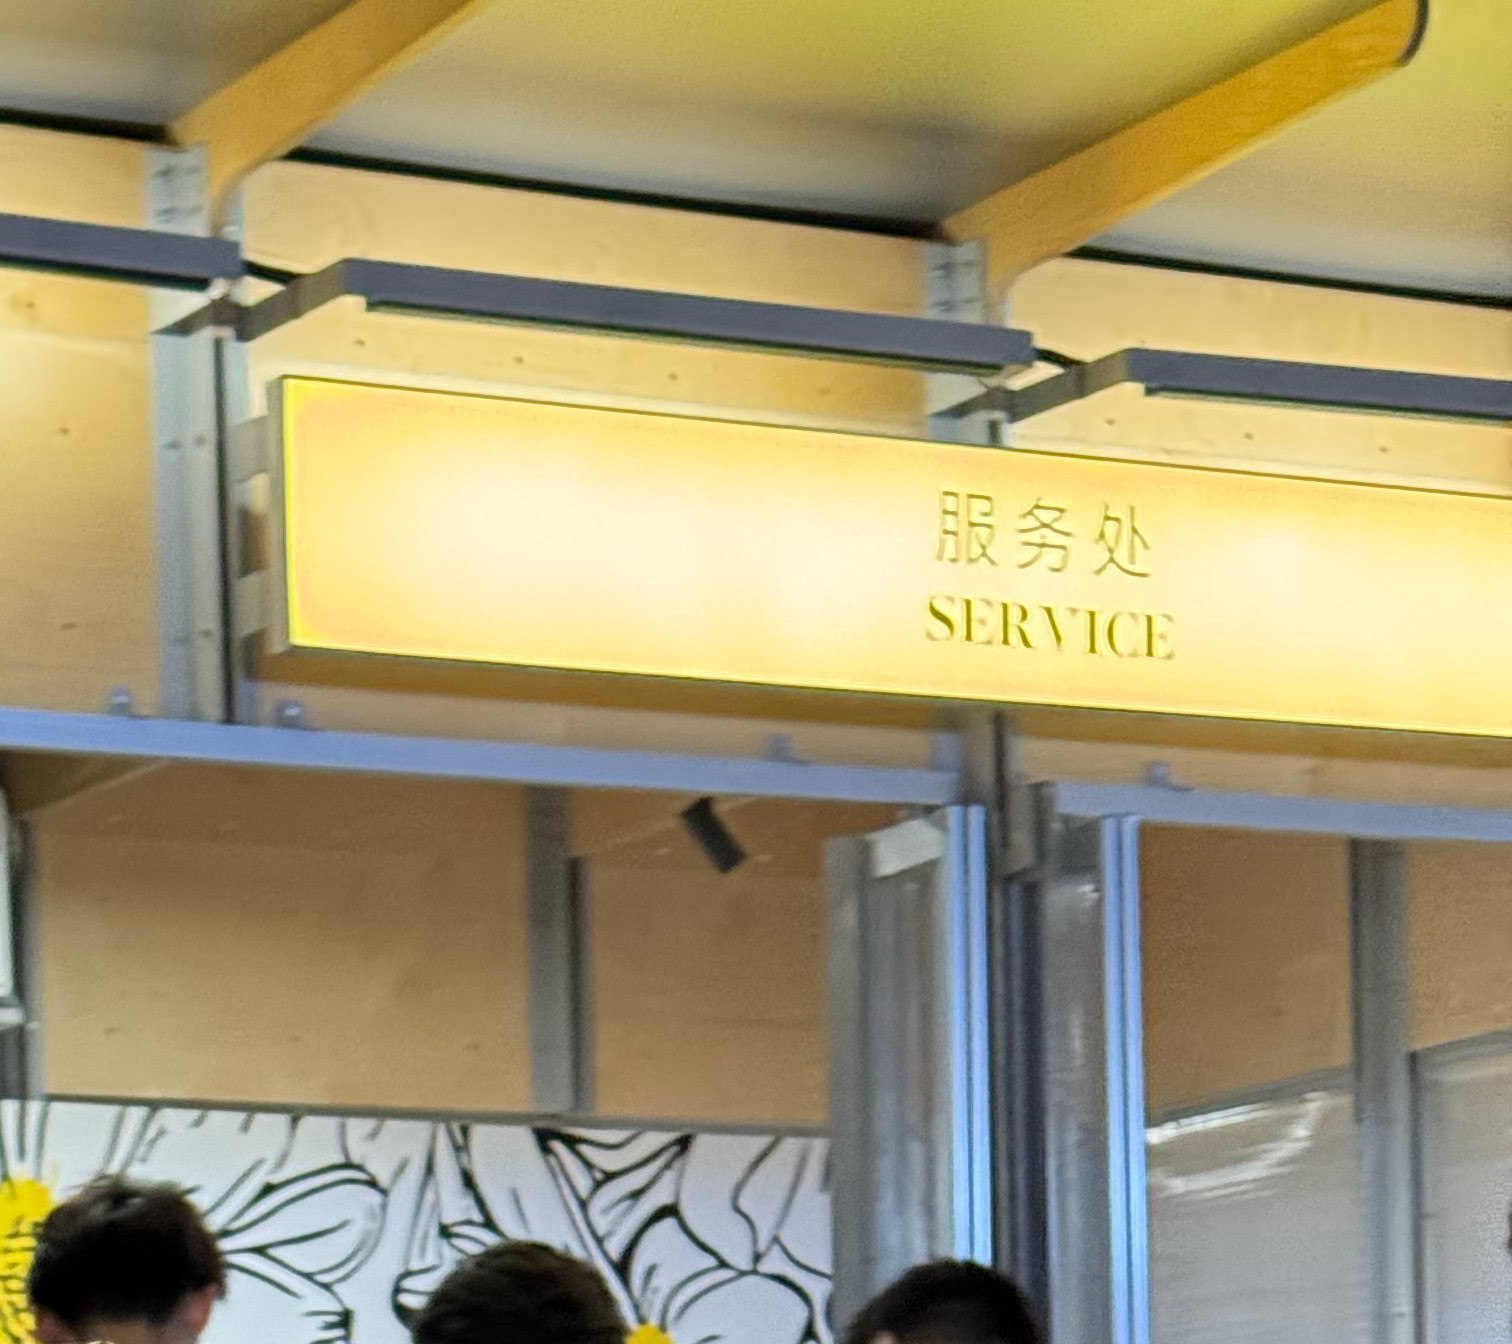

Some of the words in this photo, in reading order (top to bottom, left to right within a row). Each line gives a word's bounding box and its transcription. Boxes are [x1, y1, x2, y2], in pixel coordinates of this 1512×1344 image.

[936, 488, 1151, 578] 服务处
[925, 594, 1176, 660] SERVICE
